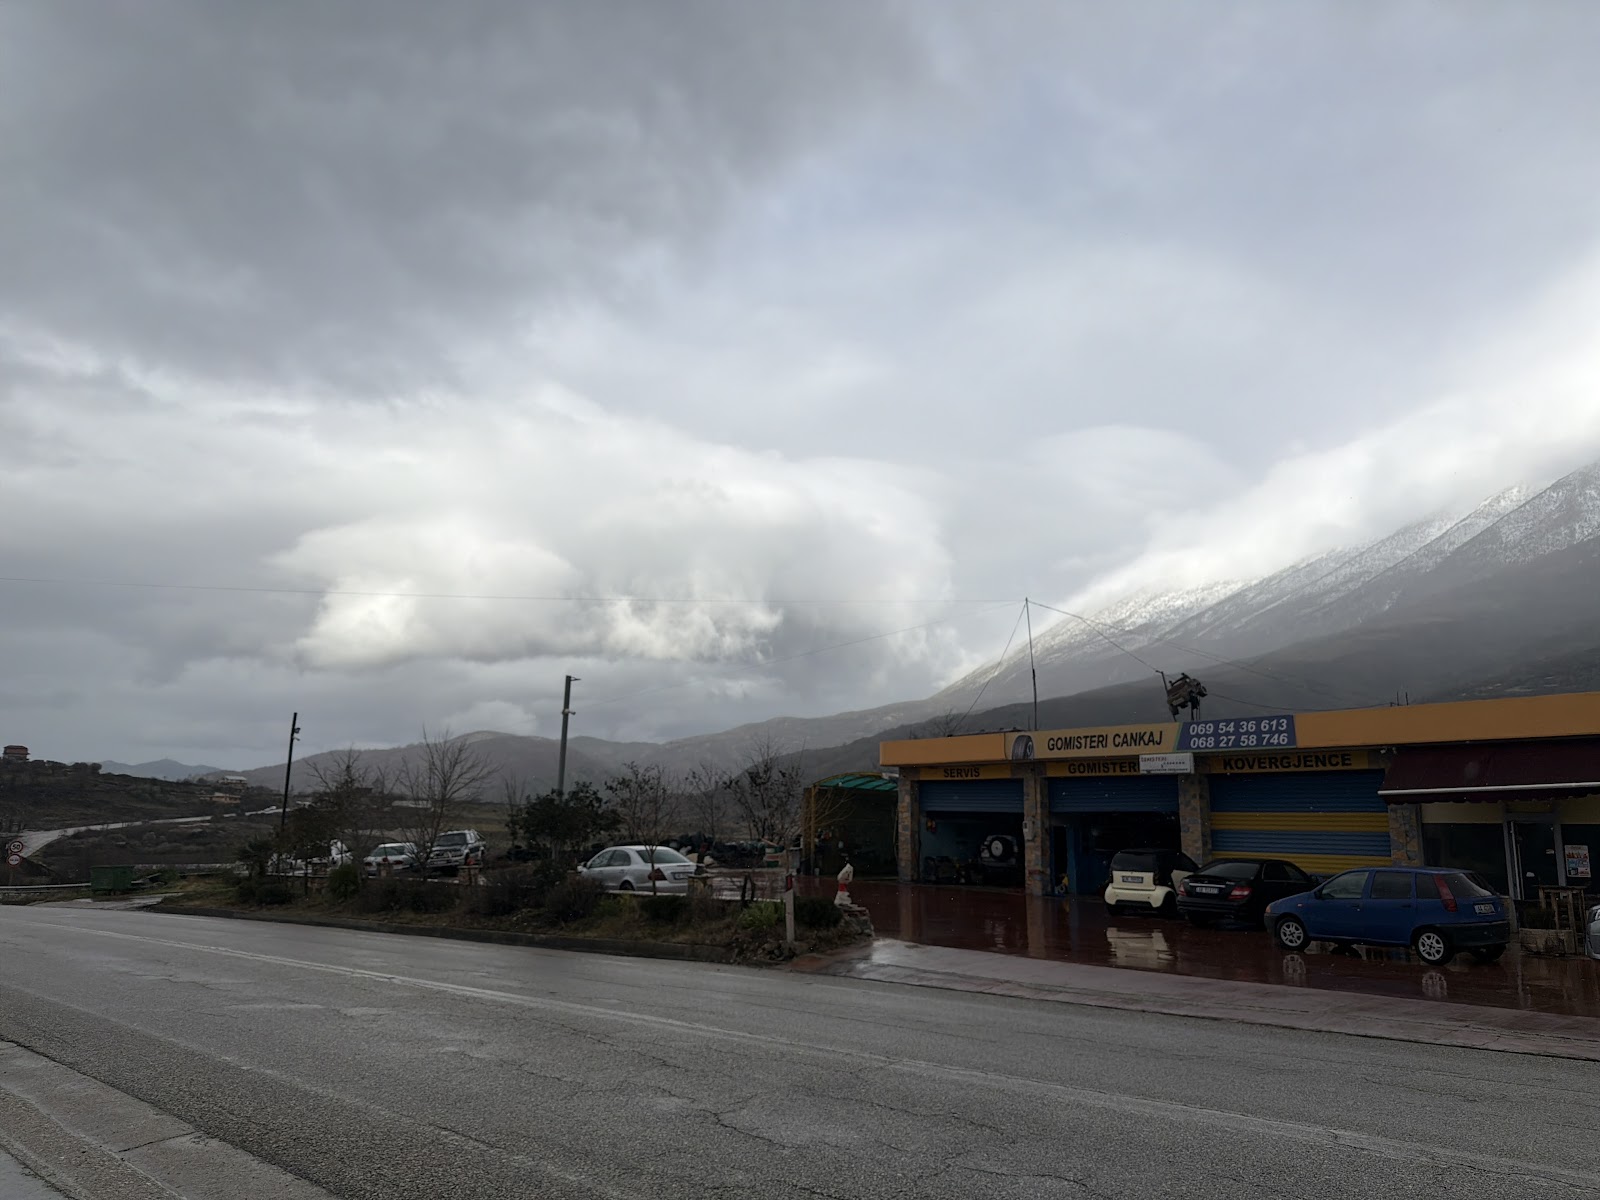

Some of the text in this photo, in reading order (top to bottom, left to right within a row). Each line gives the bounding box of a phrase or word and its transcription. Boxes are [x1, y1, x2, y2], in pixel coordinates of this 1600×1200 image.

[1189, 718, 1288, 735] 069 54 36 613
[1047, 731, 1163, 751] GOMISTERI CANKAJ
[1190, 733, 1289, 749] 068 27 58 746
[1223, 753, 1353, 770] KOVERGJENCE
[943, 767, 981, 778] SERVIS
